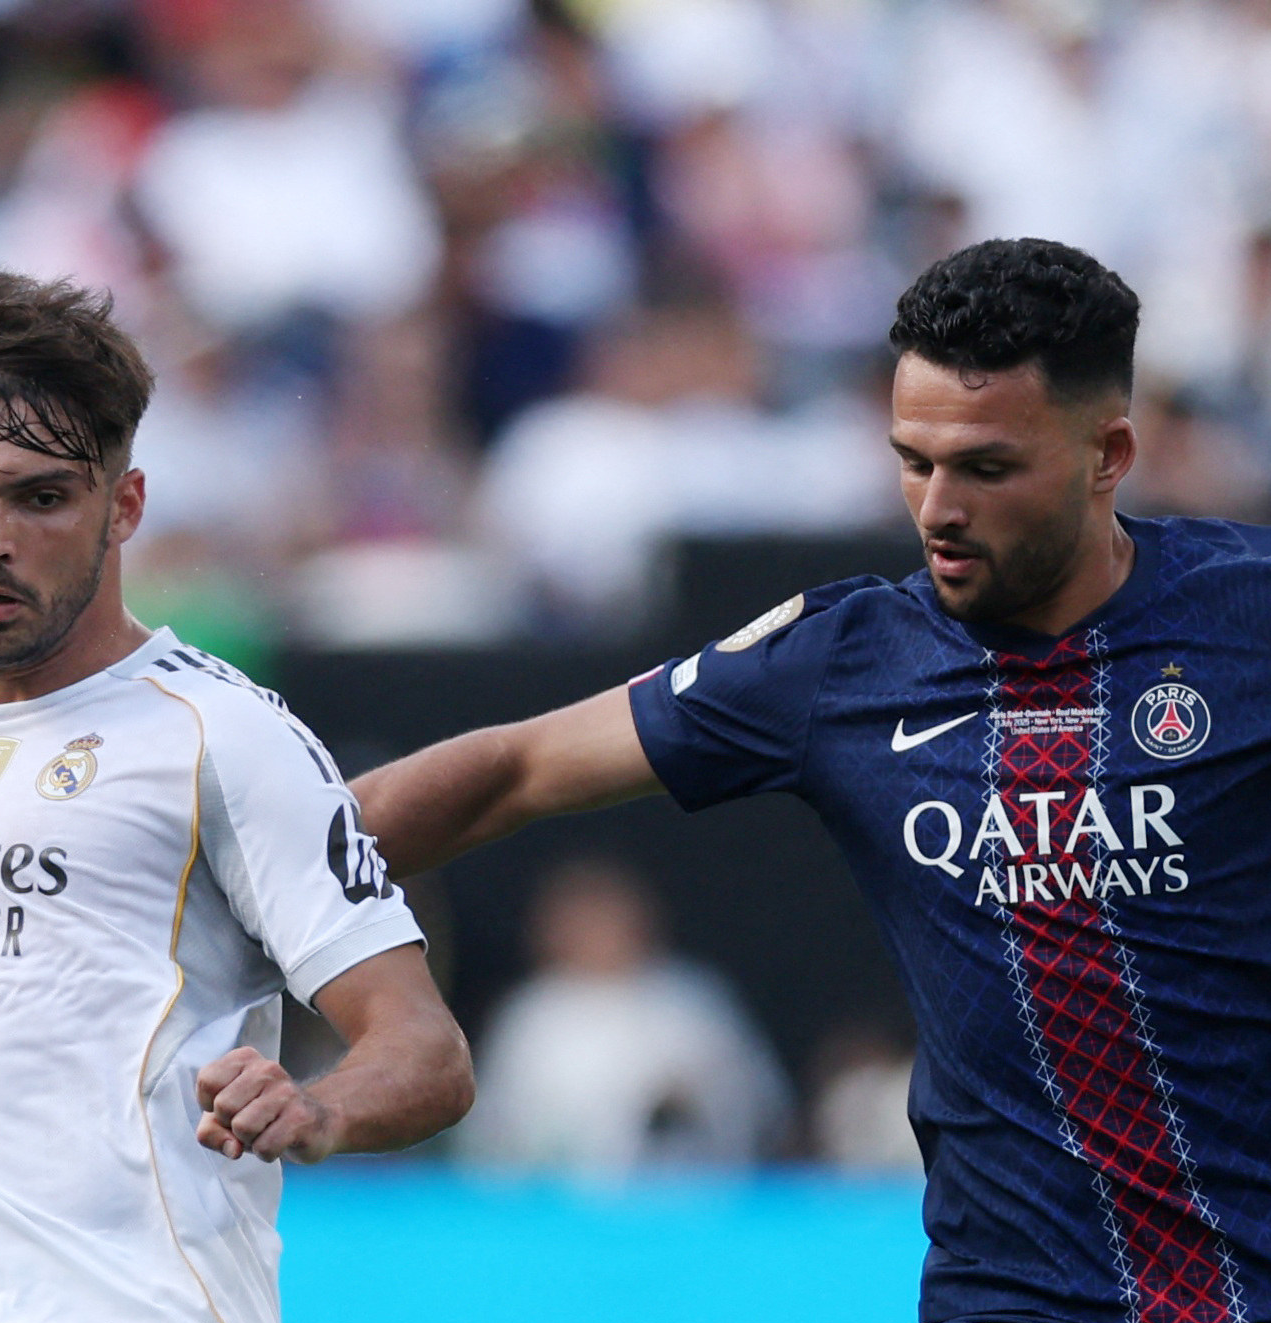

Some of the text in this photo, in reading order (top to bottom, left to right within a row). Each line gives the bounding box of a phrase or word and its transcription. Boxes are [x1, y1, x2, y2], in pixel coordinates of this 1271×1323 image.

[1145, 687, 1197, 706] PARIS
[903, 783, 1185, 879] QATAR
[974, 852, 1190, 906] AIRWAYS
